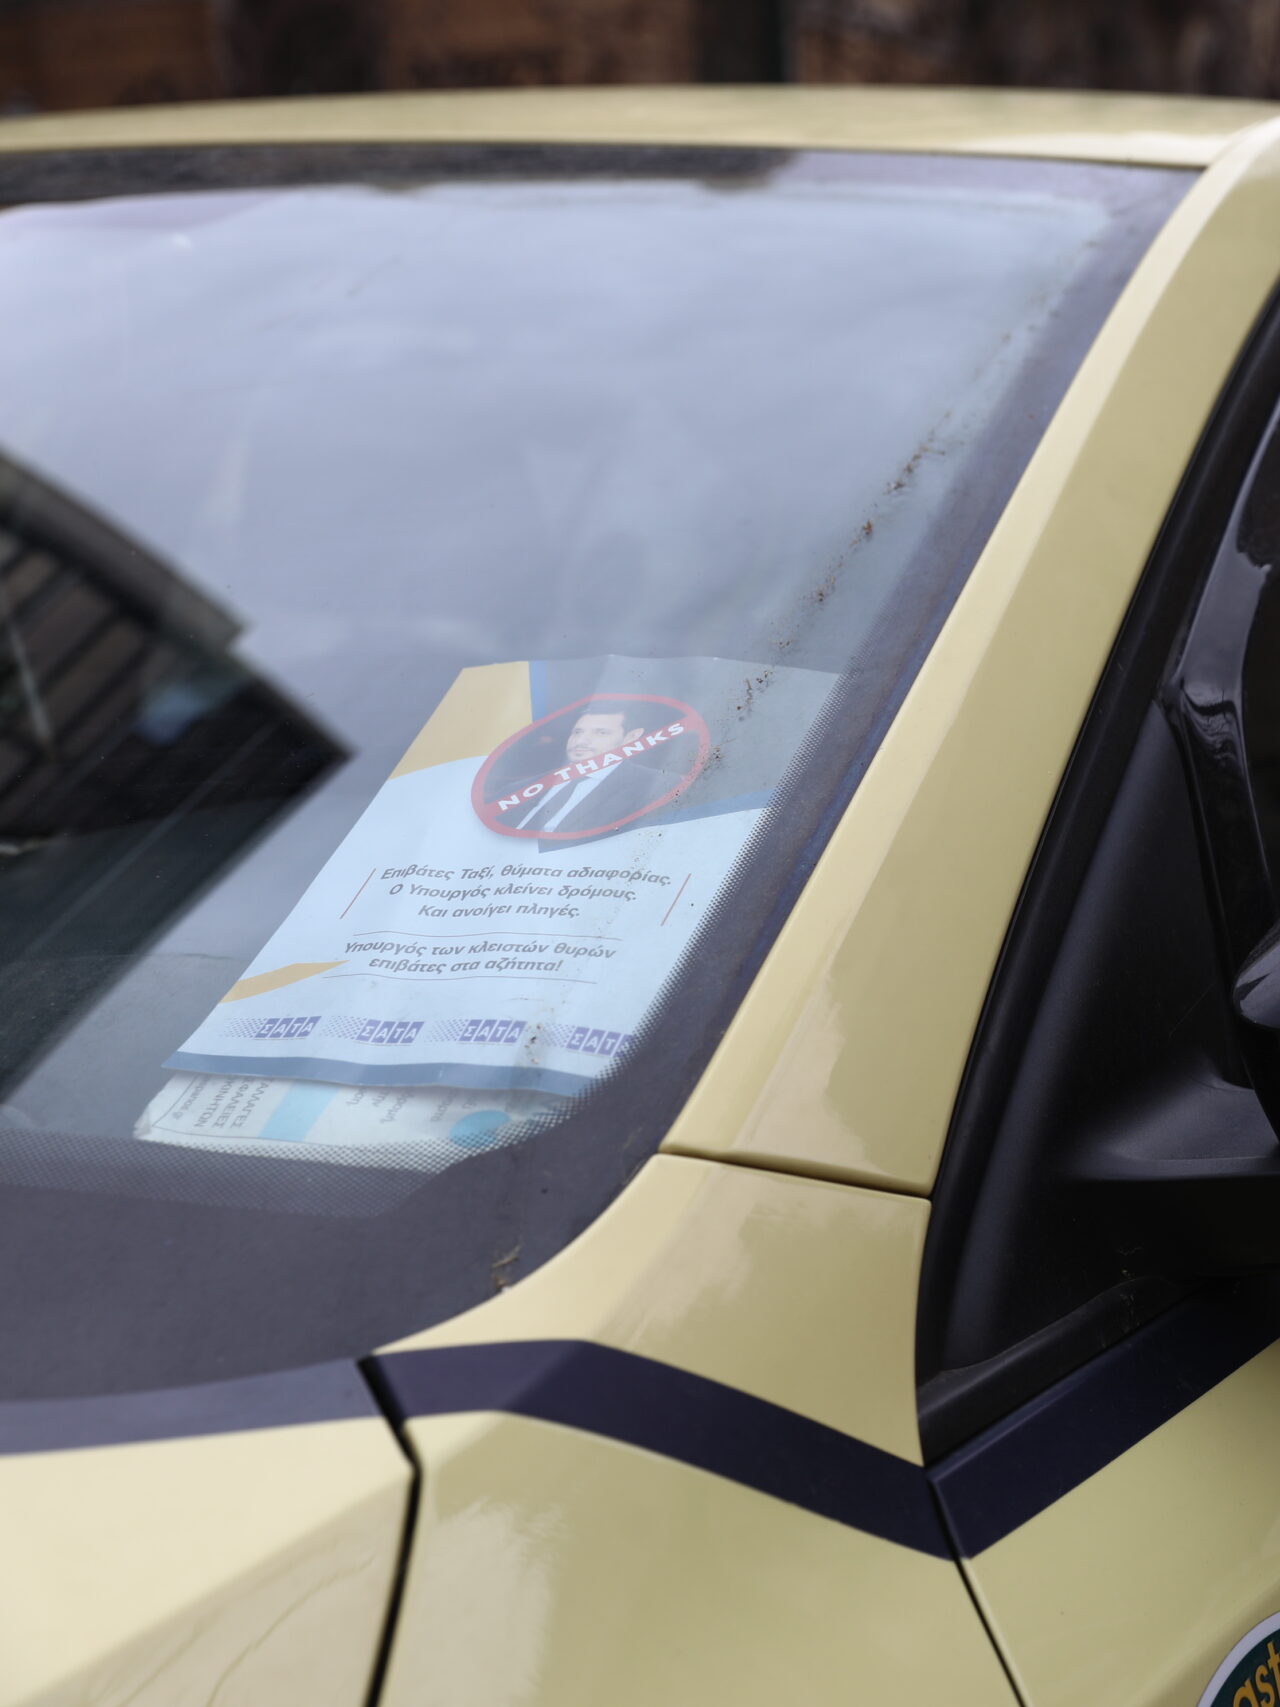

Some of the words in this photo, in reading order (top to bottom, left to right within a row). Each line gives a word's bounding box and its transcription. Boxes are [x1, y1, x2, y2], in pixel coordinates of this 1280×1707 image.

[498, 783, 544, 811] NO
[554, 723, 684, 780] THANKS
[380, 864, 455, 880] Επιβάτες
[460, 865, 496, 880] Ταξί,
[500, 864, 564, 878] θύματα
[567, 866, 671, 886] αδιαφορίας.
[409, 883, 491, 901] Υπουργός
[493, 882, 553, 896] κλείνει
[557, 884, 637, 901] δρόμους.
[418, 904, 449, 917] Και
[452, 903, 512, 917] ανοίγει
[515, 902, 580, 918] πληγές.
[344, 941, 428, 957] Υπουργός
[431, 945, 466, 956] των
[467, 940, 550, 955] κλειστών
[553, 942, 616, 959] θυρών
[368, 957, 447, 974] επιβάτες
[450, 960, 481, 973] στα
[484, 957, 564, 972] αζήτητα!
[257, 1020, 317, 1036] ΣΑΤΑ
[359, 1023, 419, 1041] ΣΑΤΑ
[461, 1022, 523, 1040] ΣΑΤΑ
